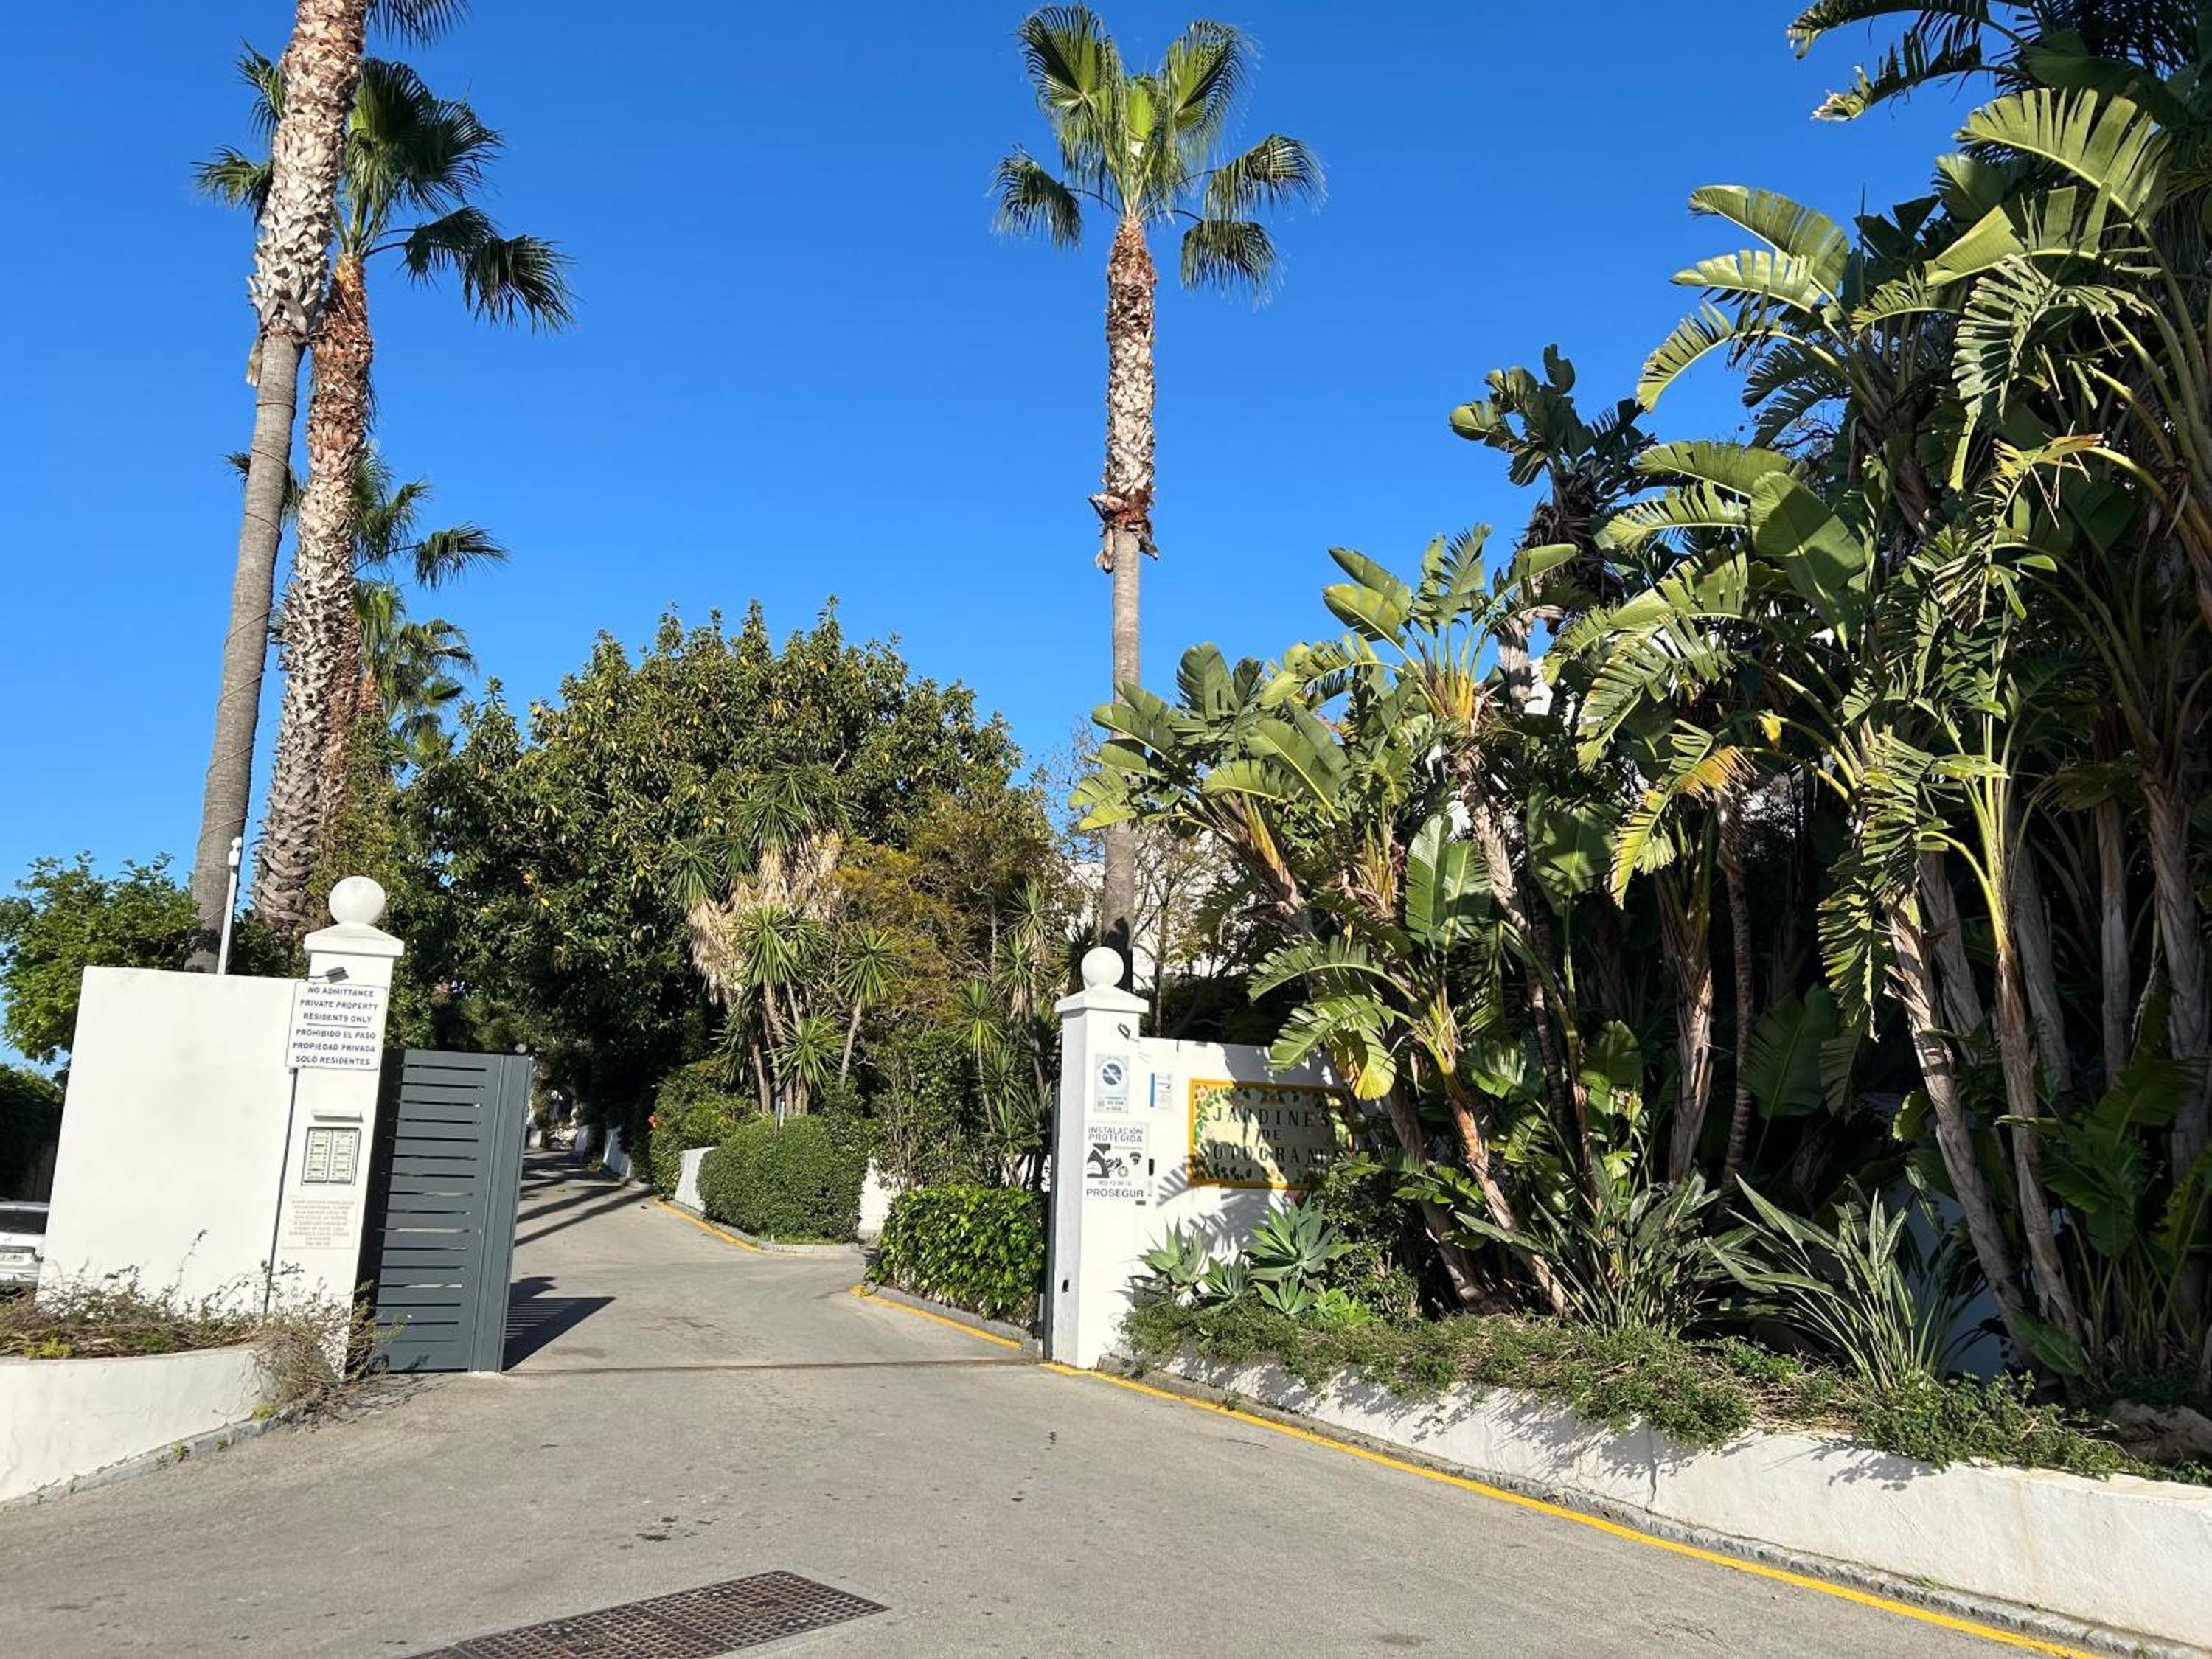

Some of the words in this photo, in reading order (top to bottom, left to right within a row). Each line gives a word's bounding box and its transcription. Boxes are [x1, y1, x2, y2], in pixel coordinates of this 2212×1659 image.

[307, 986, 320, 995] NO
[322, 988, 374, 998] ADMITTANCE
[300, 999, 334, 1008] PRIVATE
[335, 1001, 378, 1011] PROPERTY
[303, 1012, 349, 1022] RESIDENTS
[350, 1015, 372, 1023] ONLY
[296, 1029, 341, 1038] PROHIBIDO
[343, 1031, 352, 1039] EL
[355, 1032, 376, 1040] PASO
[293, 1042, 338, 1051] PROPIEDAD
[341, 1044, 375, 1053] PRIVADA
[296, 1055, 318, 1063] SOLO
[319, 1056, 370, 1065] RESIDENTES
[1213, 1107, 1330, 1127] JARDINES
[1088, 1126, 1143, 1136] INSTALACIÓN
[1262, 1129, 1281, 1141] DE
[1088, 1134, 1142, 1143] PROTEGIDA
[1198, 1143, 1343, 1164] SOTOGRAN
[1086, 1188, 1144, 1198] PROSEGUR
